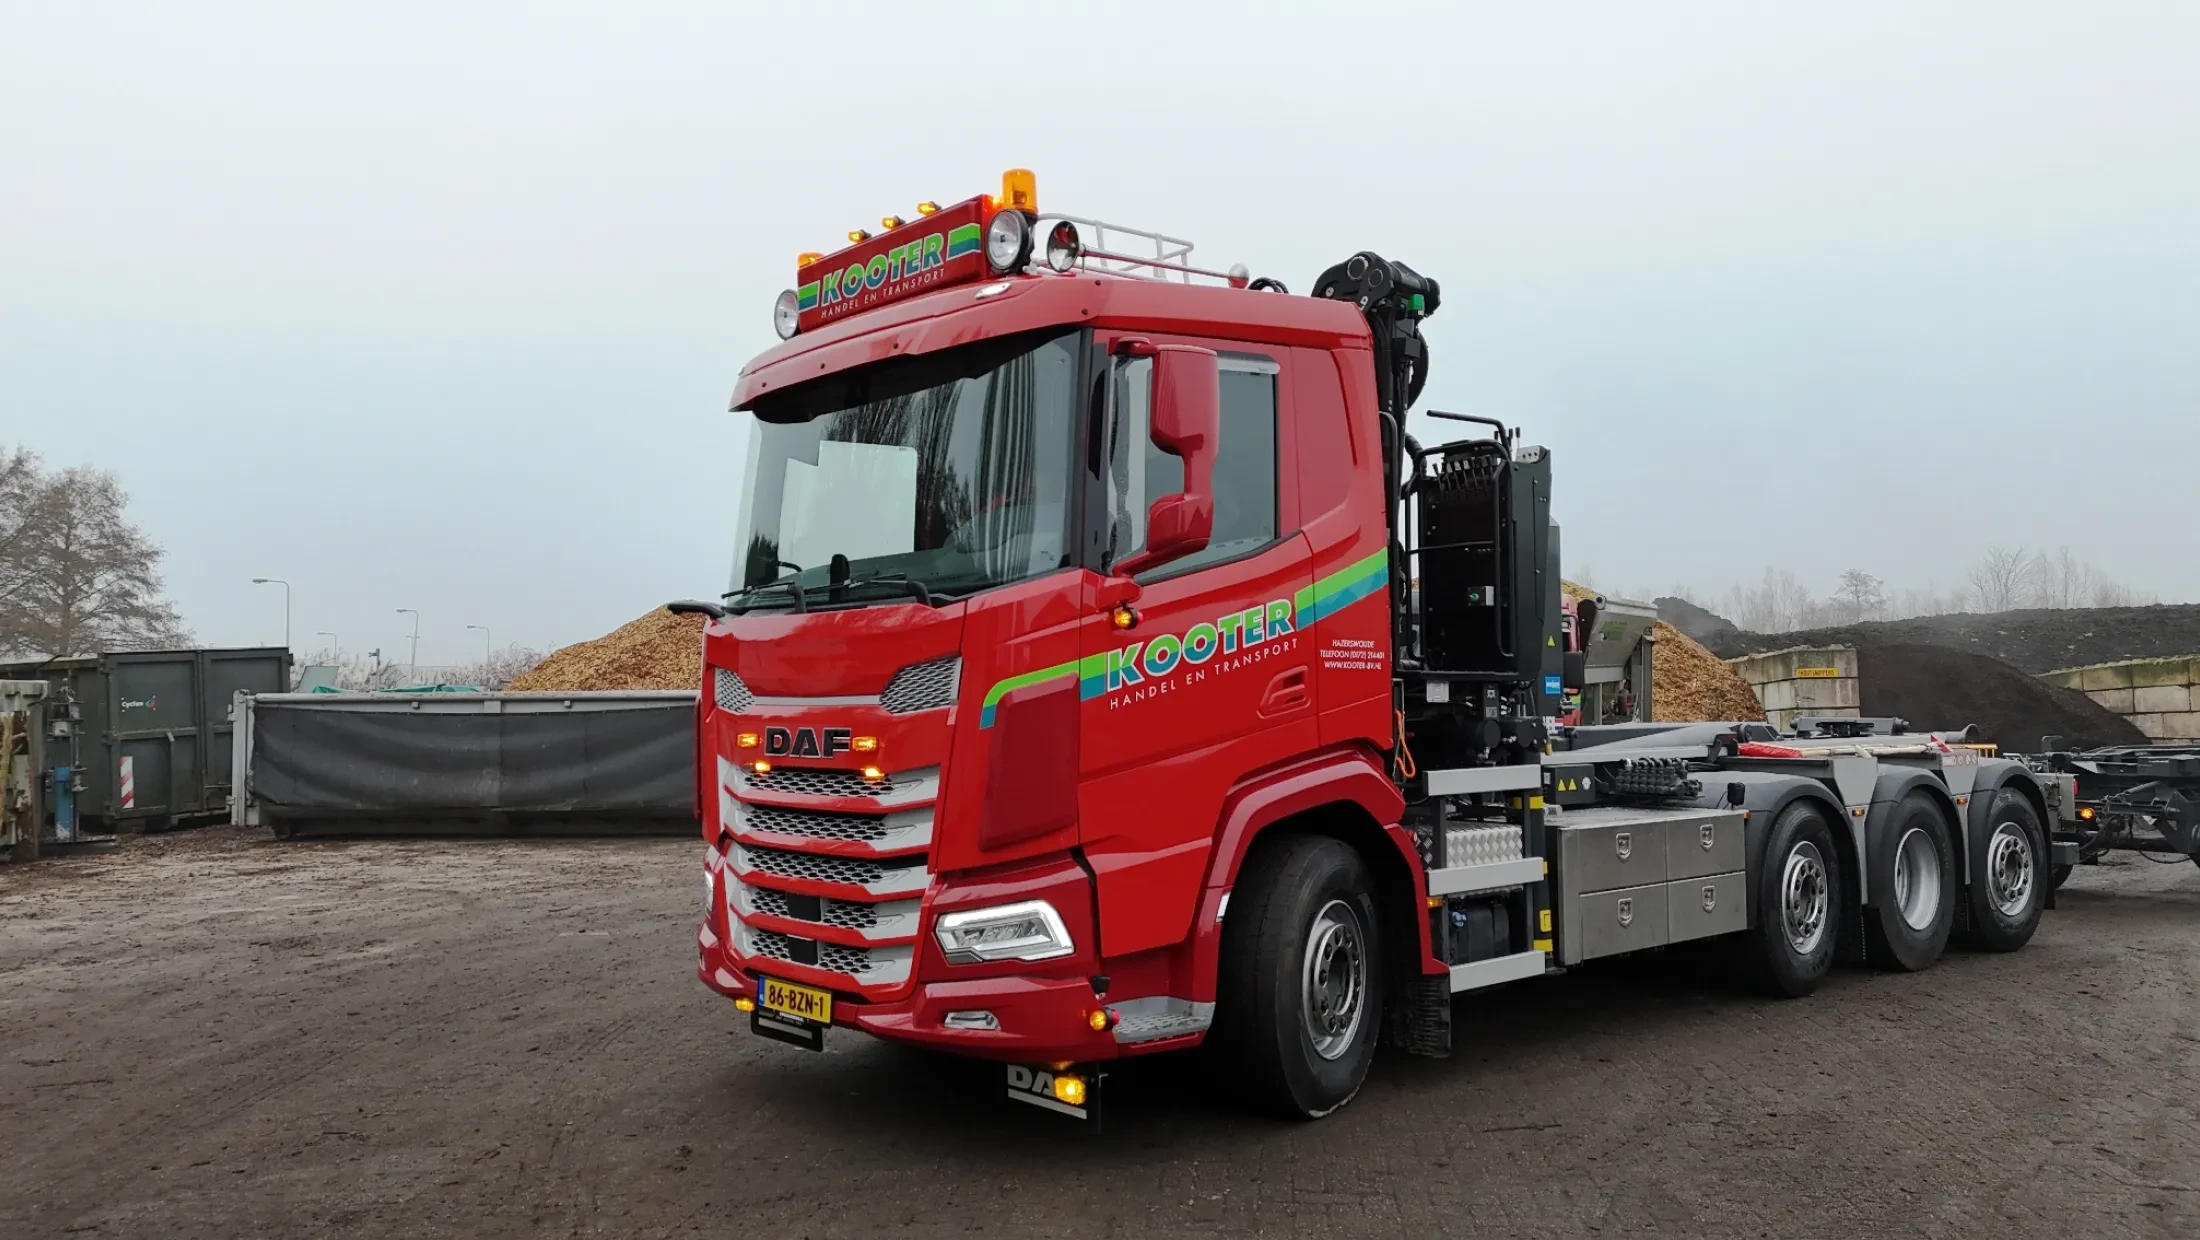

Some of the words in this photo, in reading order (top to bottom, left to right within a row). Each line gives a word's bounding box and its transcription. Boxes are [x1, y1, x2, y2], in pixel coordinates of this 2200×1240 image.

[821, 233, 944, 307] KOOTER
[820, 299, 859, 319] HANDEL
[864, 291, 877, 304] EN
[883, 268, 945, 299] TRANSPORT
[1106, 599, 1294, 692] KOOTER
[1320, 649, 1349, 658] TELEFOON
[1332, 639, 1375, 648] HAZERSWOUDE
[1109, 679, 1176, 710] HANDEL
[1186, 669, 1205, 685] EN
[1215, 638, 1298, 676] TRANSPORT
[764, 726, 852, 759] DAF
[768, 984, 824, 1018] 86-BZN-1
